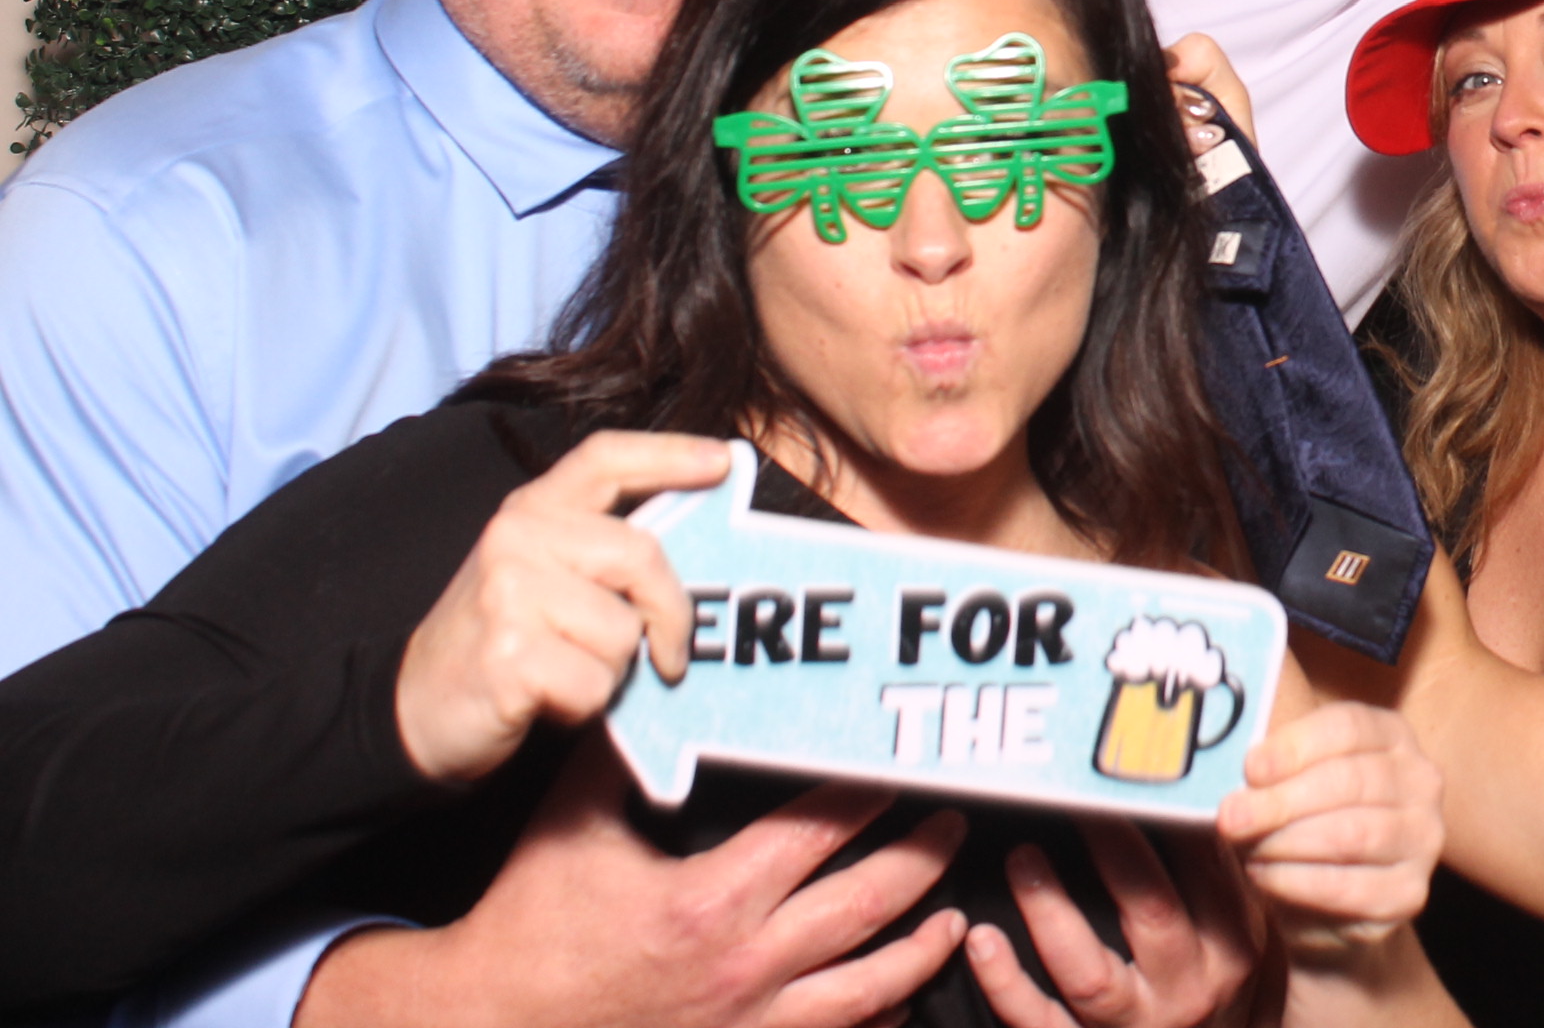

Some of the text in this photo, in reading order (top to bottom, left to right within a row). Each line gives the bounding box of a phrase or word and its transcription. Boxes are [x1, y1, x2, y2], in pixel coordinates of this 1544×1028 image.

[688, 586, 1075, 667] ERE FOR
[880, 680, 1059, 768] THE
